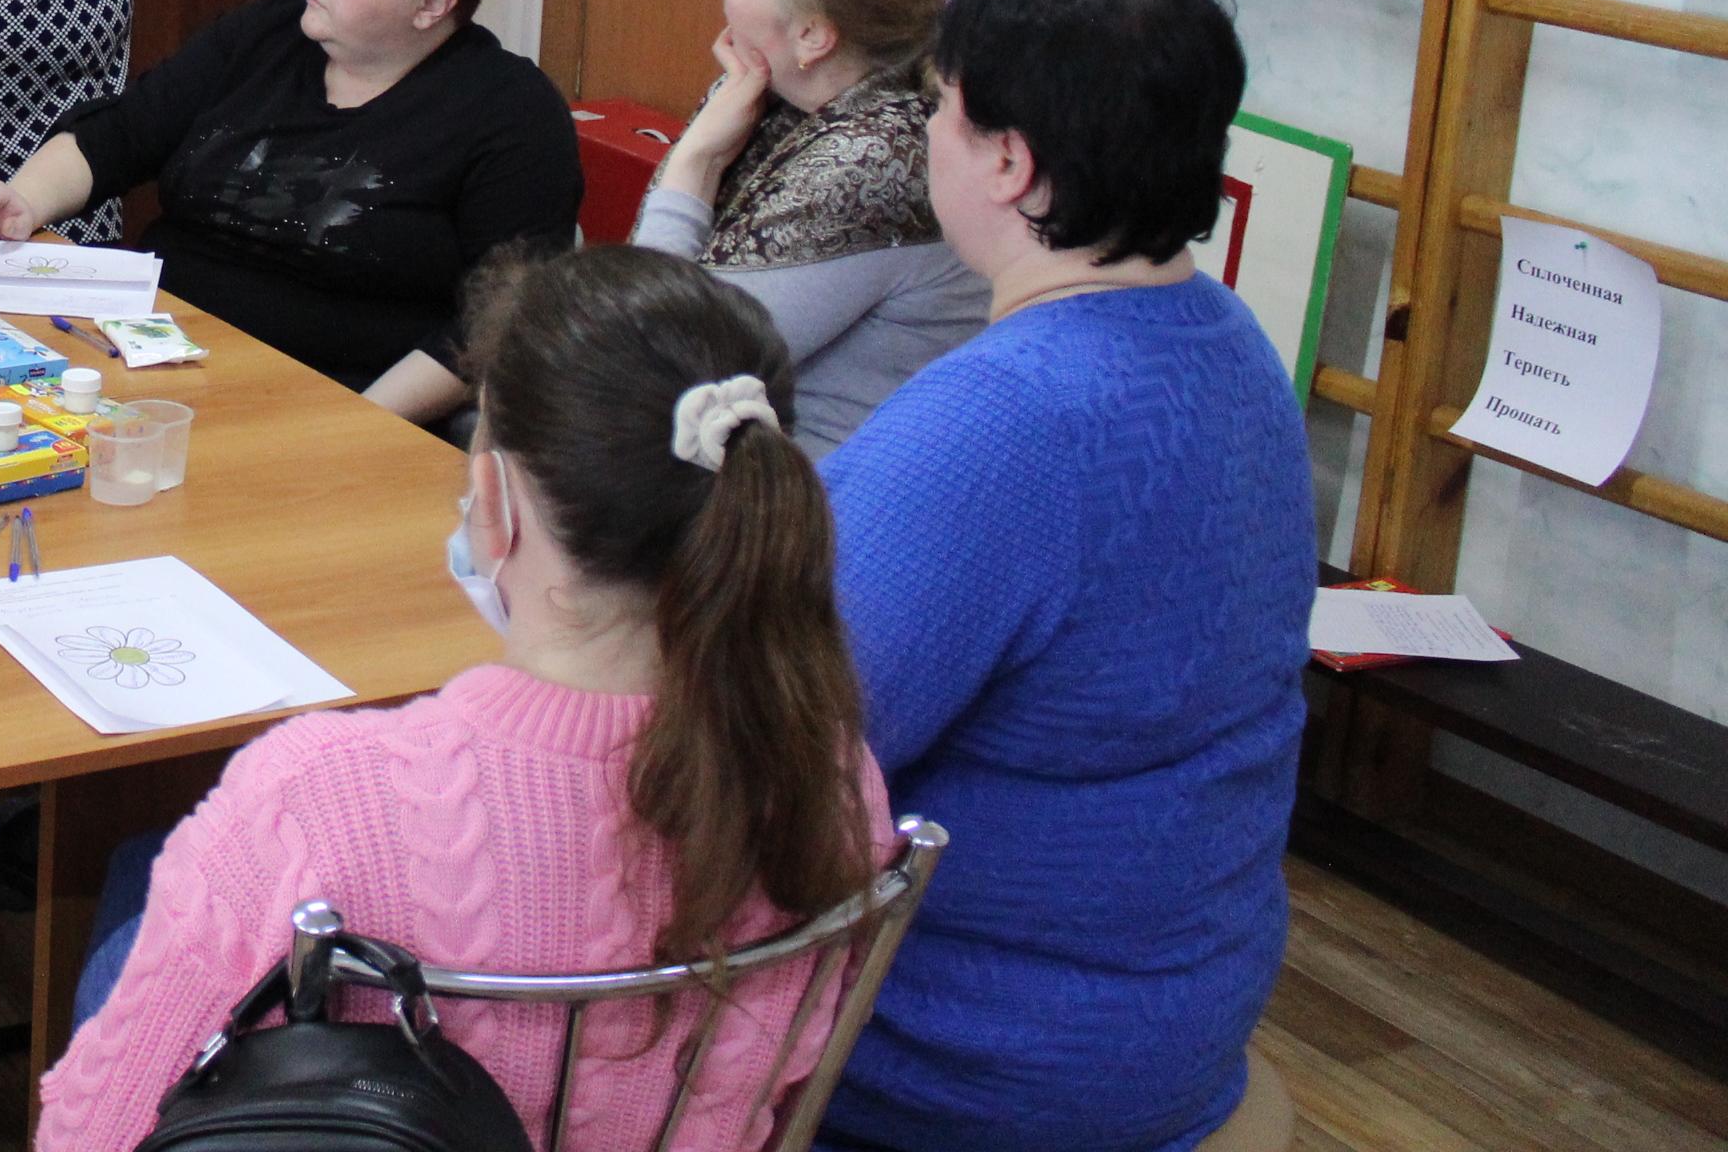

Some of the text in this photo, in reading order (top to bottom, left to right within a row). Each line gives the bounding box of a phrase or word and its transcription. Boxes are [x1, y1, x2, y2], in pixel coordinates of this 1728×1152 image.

[1517, 258, 1623, 305] Сплоченная
[1511, 304, 1597, 345] Надежная
[1504, 349, 1571, 387] Терпеть
[1485, 395, 1561, 435] Прощать
